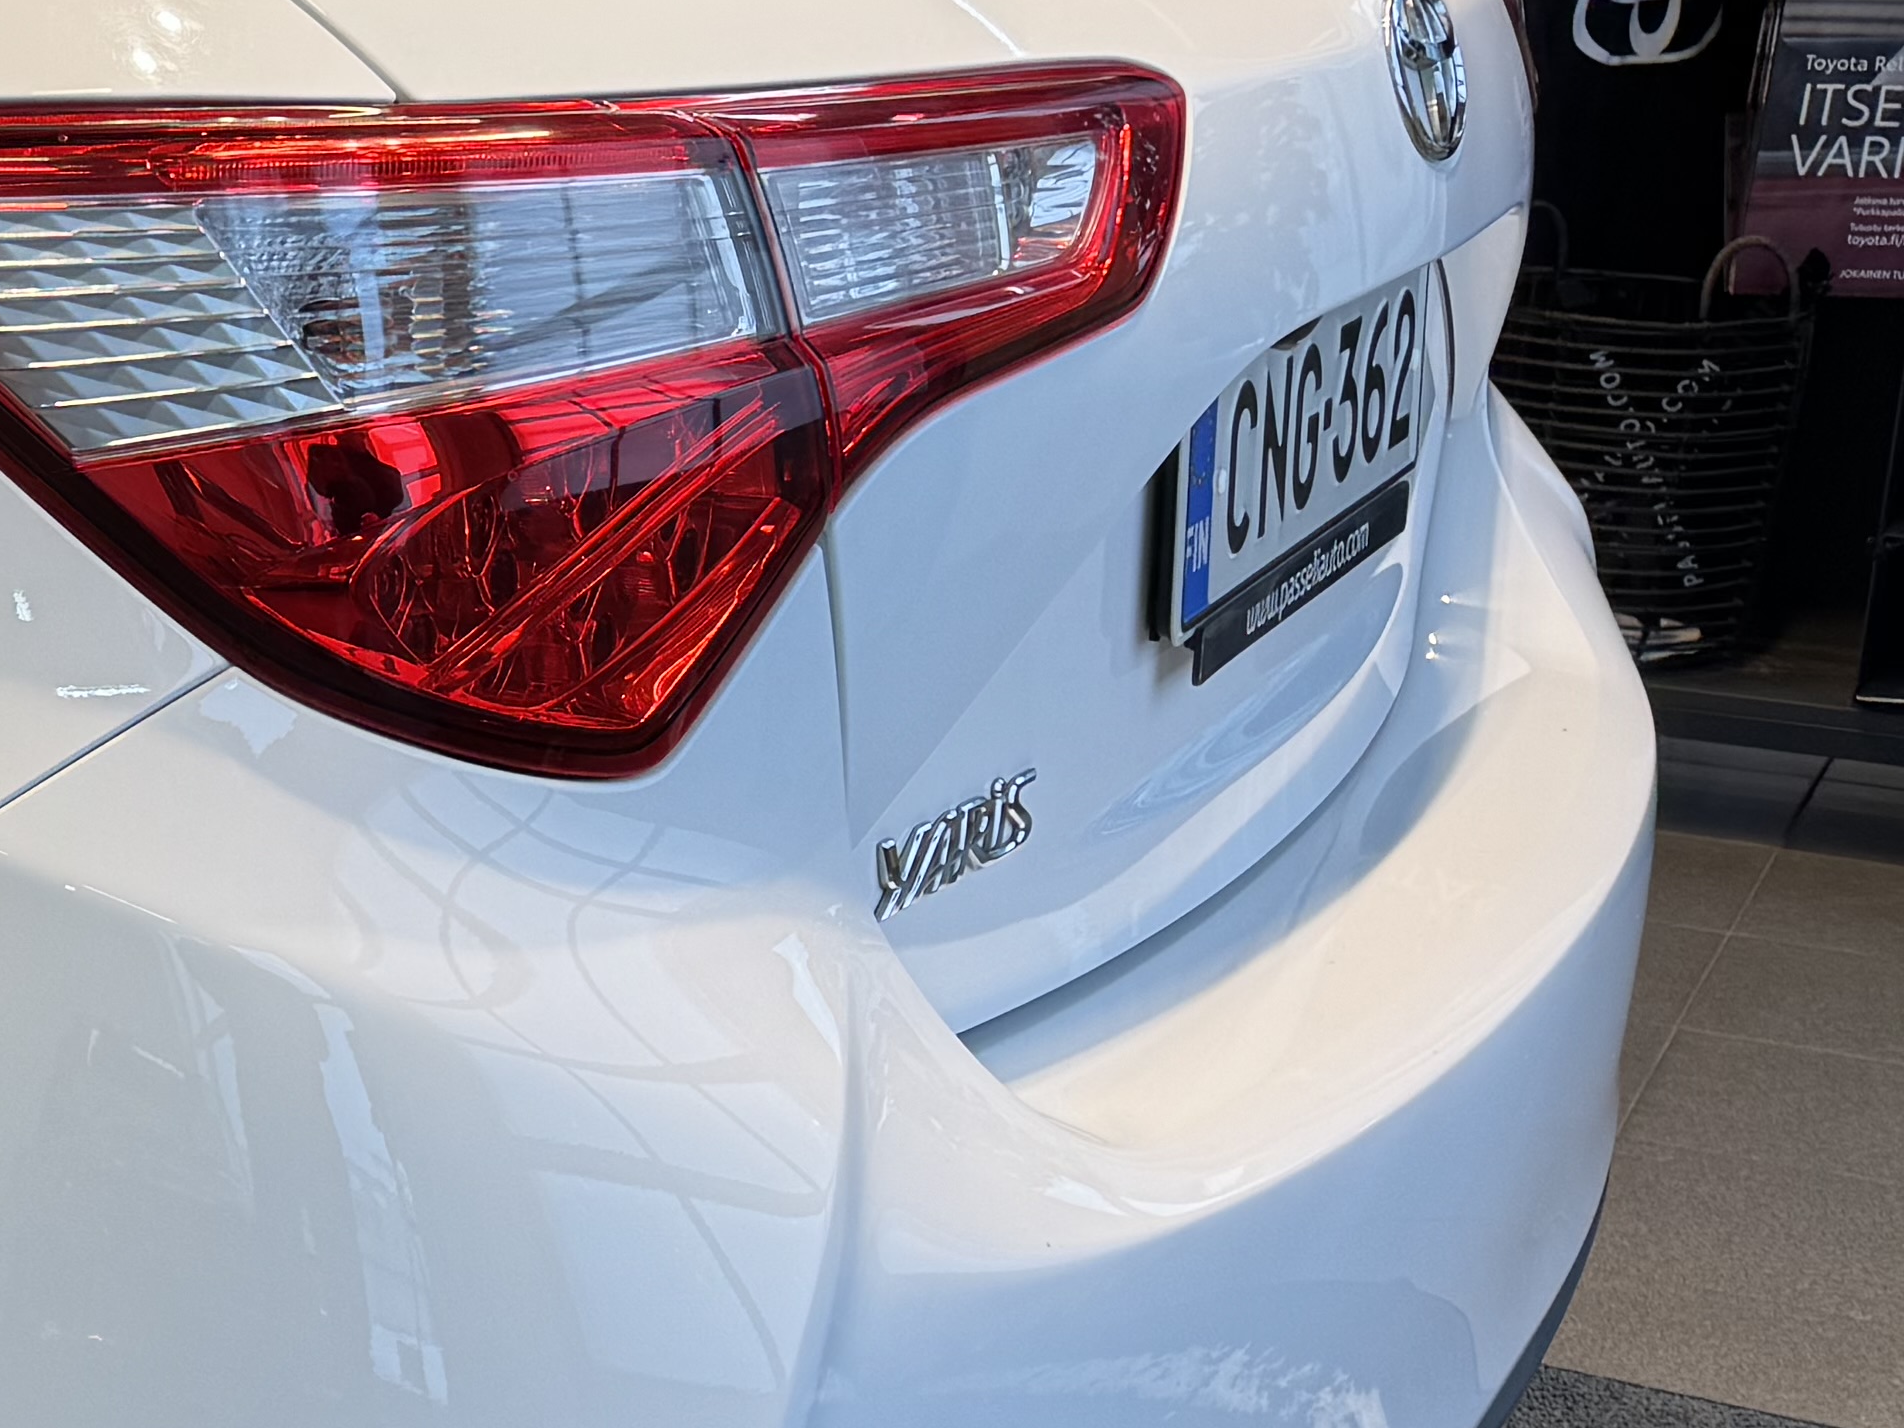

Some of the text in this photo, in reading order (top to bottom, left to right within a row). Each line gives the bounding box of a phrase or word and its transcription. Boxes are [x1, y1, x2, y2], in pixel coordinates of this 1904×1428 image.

[1806, 54, 1868, 75] Toyota
[1798, 82, 1904, 127] ITSE
[1226, 287, 1416, 555] CNG-362
[1186, 515, 1210, 572] FIN
